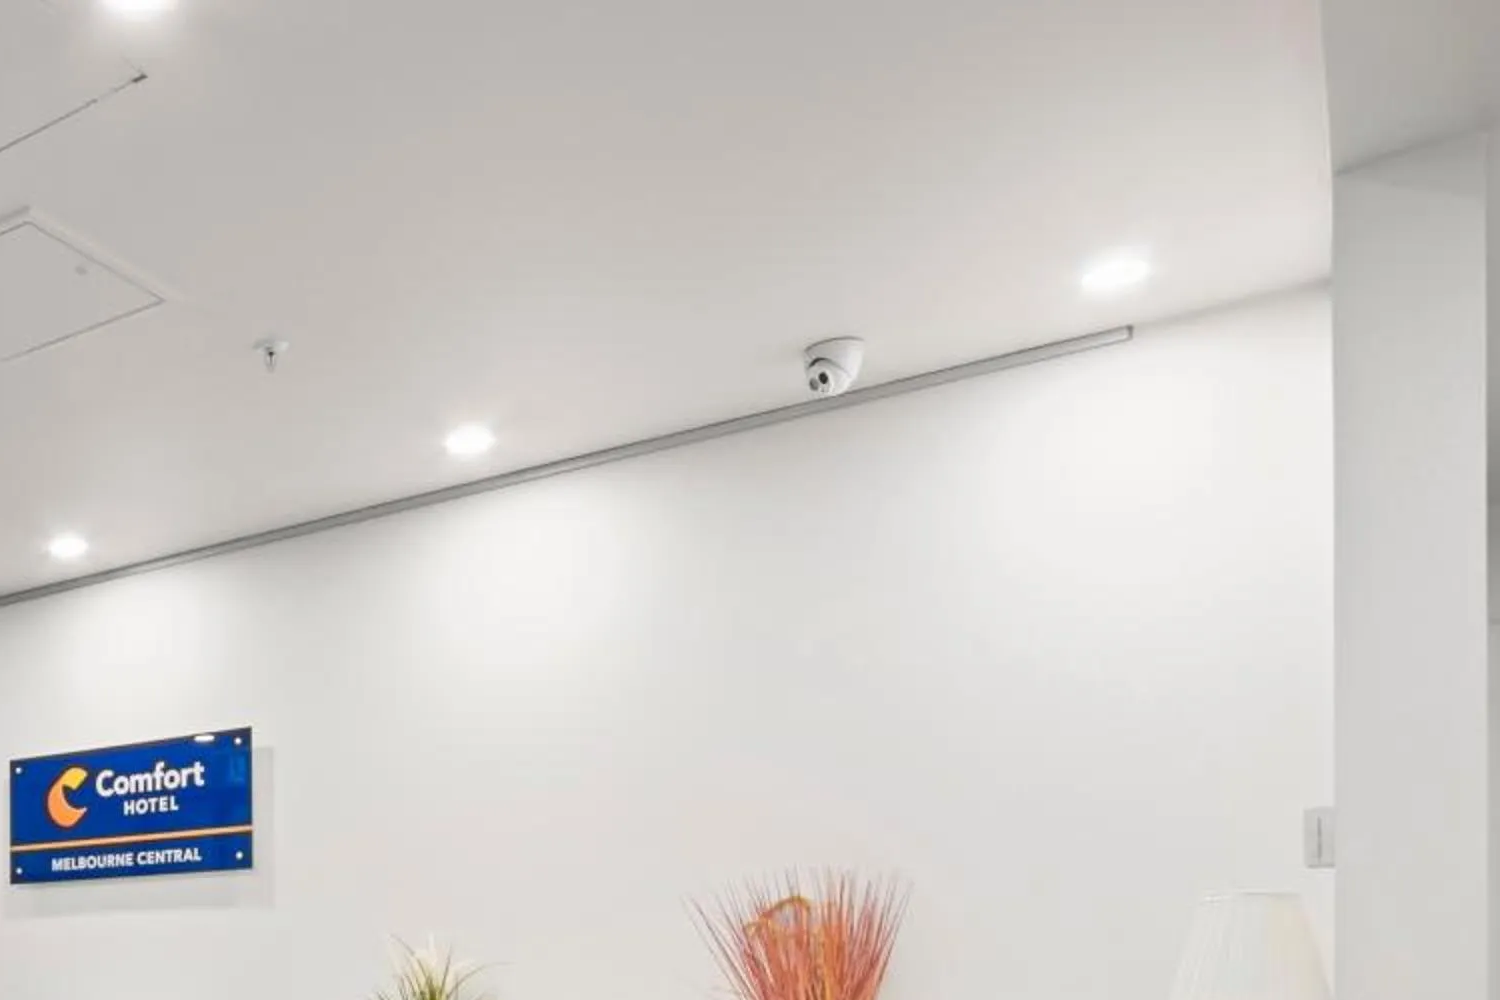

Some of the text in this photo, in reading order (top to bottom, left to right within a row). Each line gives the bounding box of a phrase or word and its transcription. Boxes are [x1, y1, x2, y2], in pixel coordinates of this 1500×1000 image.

[95, 761, 205, 798] Comfort
[123, 796, 179, 816] HOTEL
[51, 847, 202, 872] MELBOURNE CENTRAL
